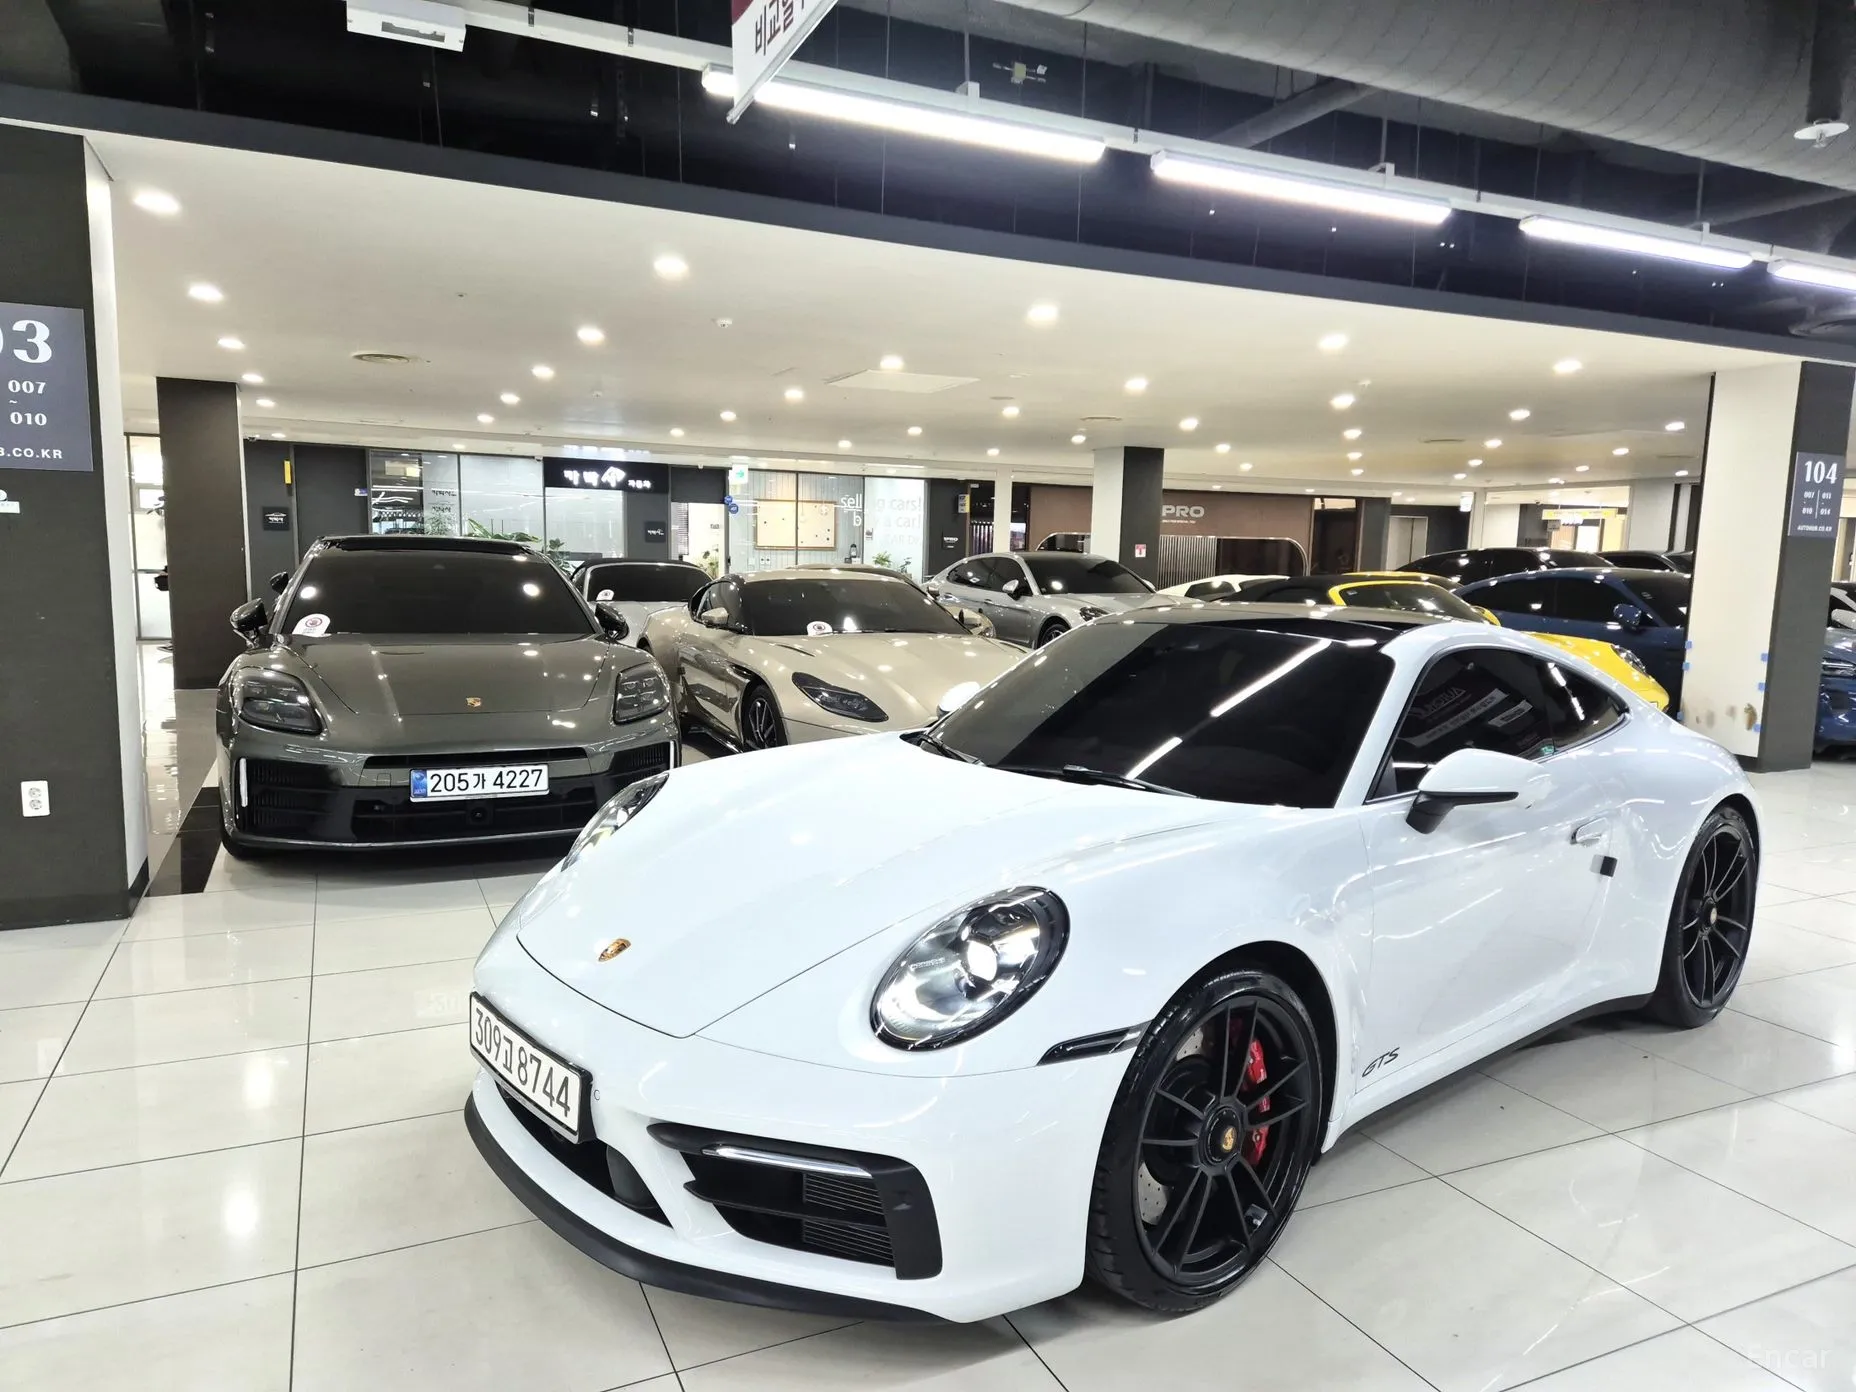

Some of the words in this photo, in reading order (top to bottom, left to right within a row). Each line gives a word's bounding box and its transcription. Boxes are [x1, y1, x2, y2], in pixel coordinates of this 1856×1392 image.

[0, 319, 53, 364] 3
[8, 379, 47, 394] 007
[10, 411, 48, 427] 010
[1804, 460, 1838, 485] 104
[430, 772, 487, 793] 205가
[492, 768, 544, 789] 4227
[475, 1006, 513, 1075] 309고
[517, 1045, 571, 1118] 8744
[1361, 1046, 1401, 1078] GTS
